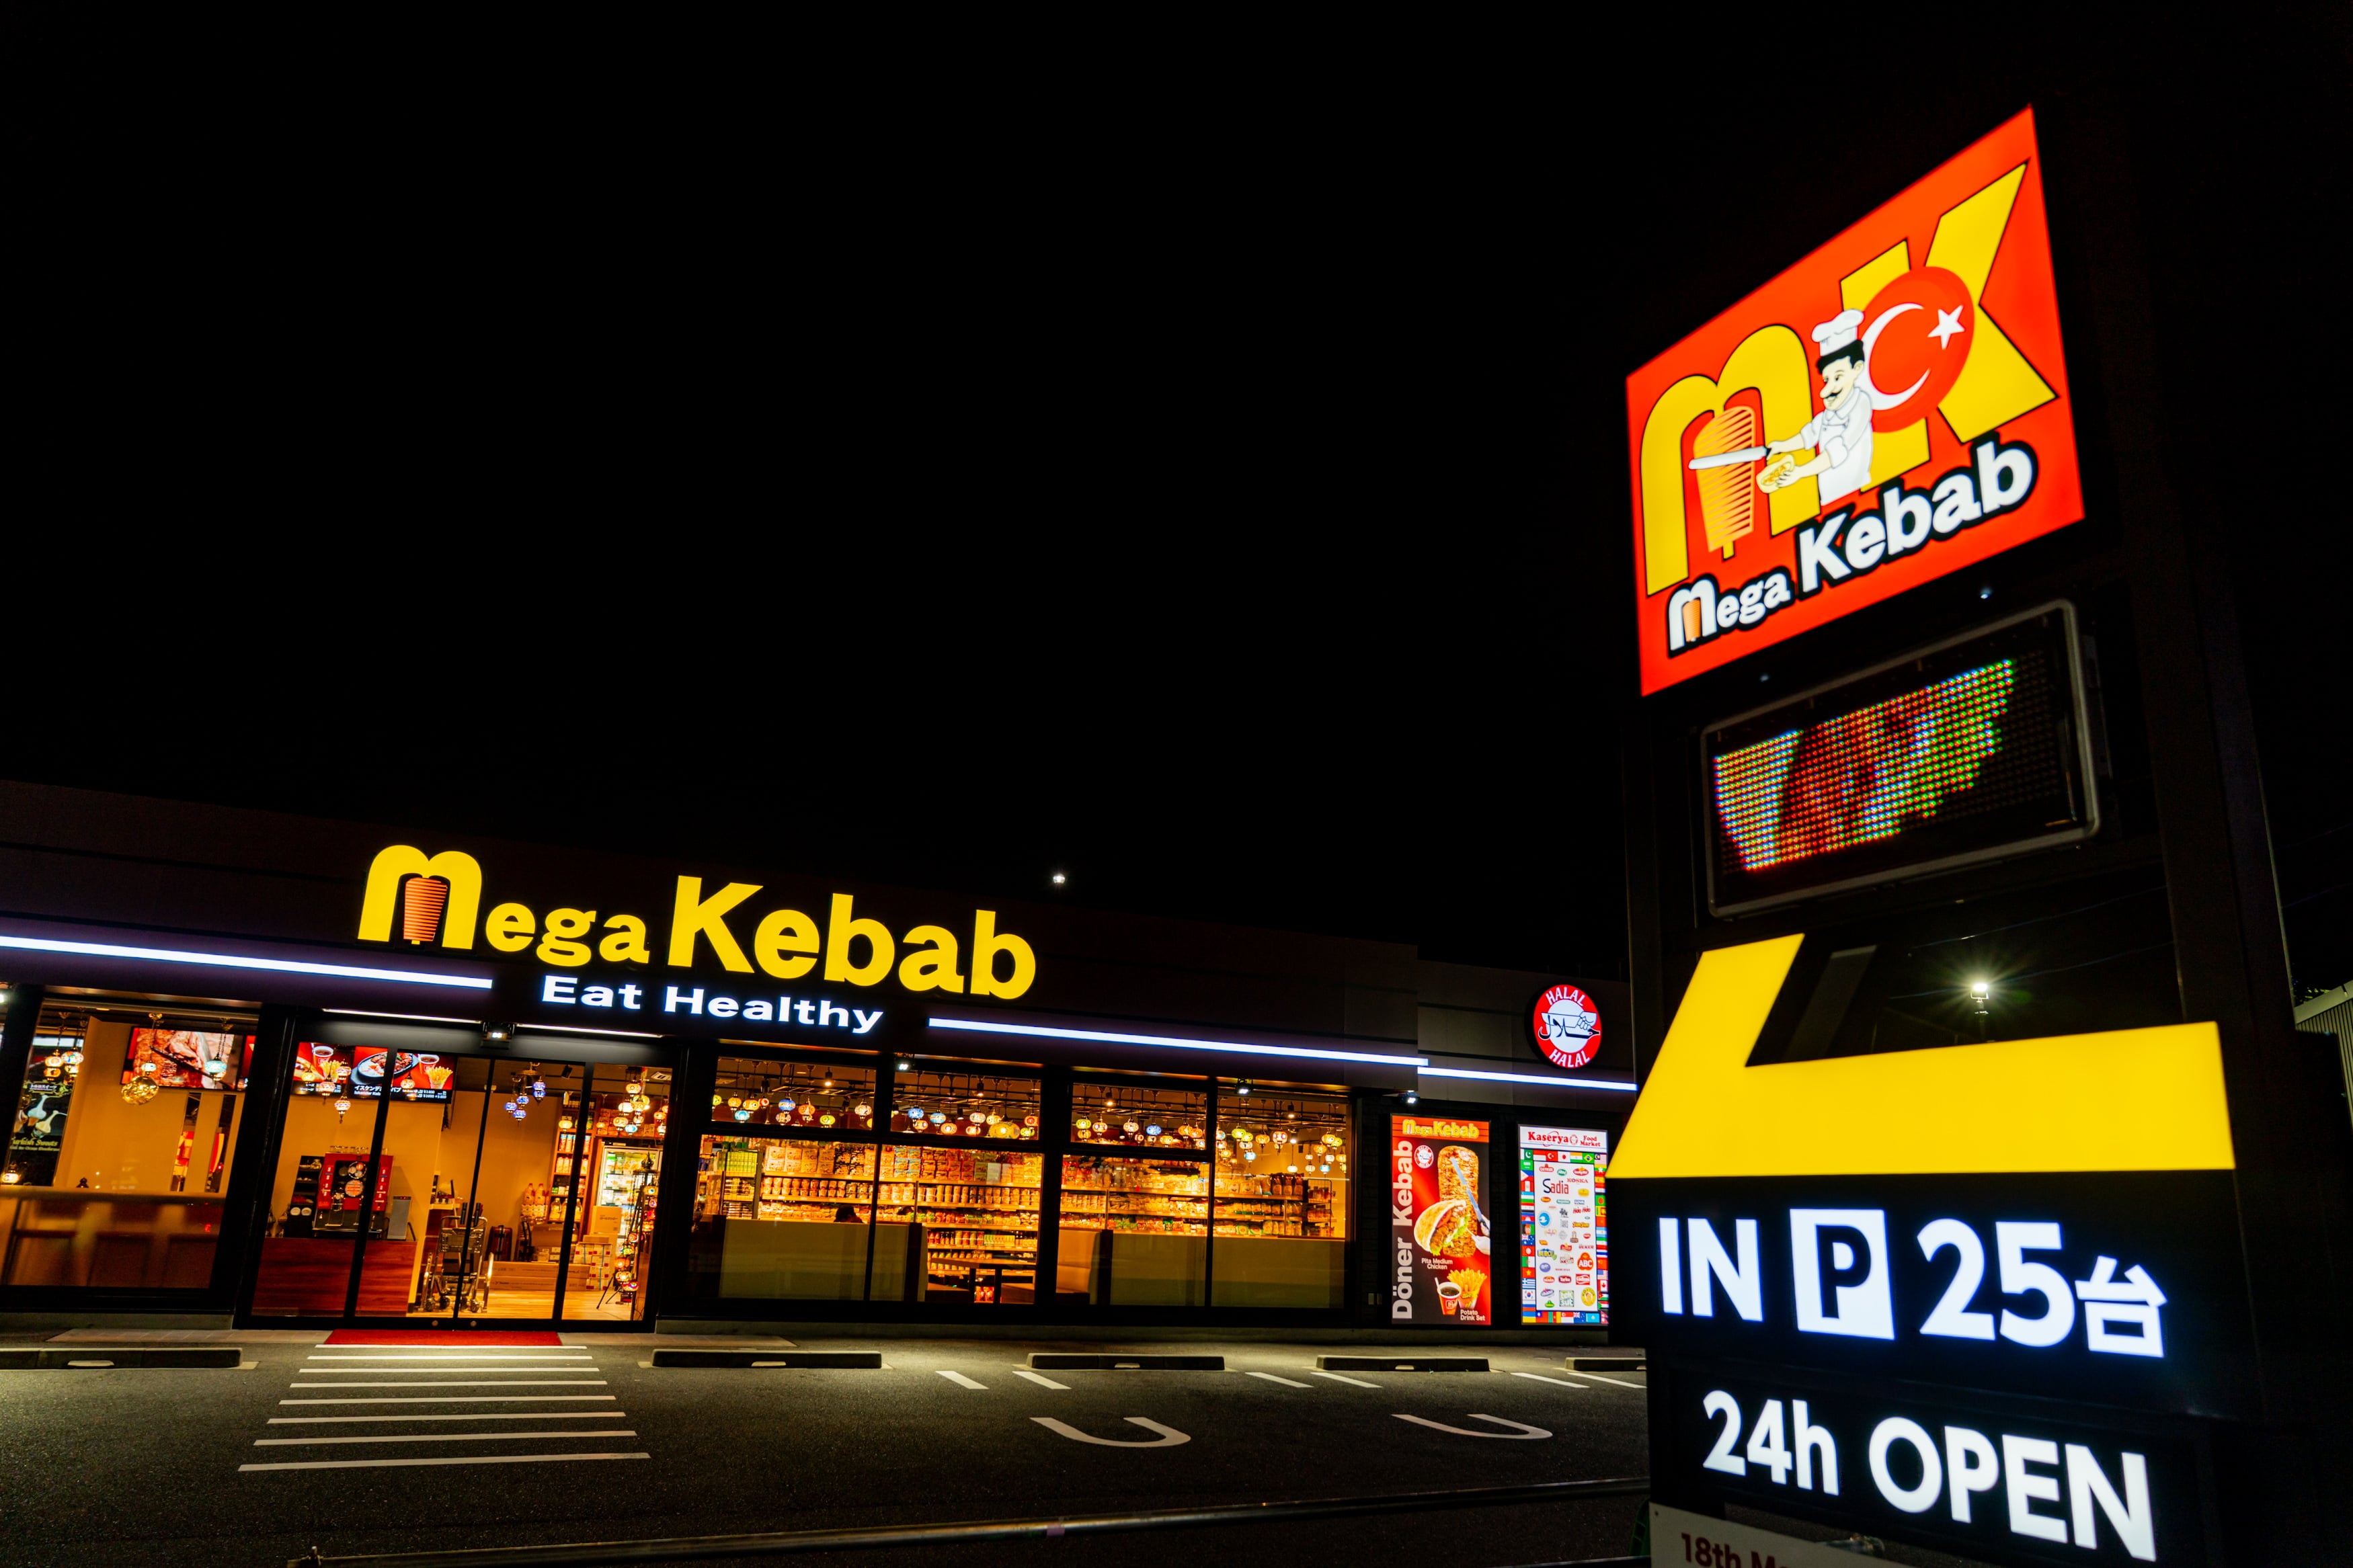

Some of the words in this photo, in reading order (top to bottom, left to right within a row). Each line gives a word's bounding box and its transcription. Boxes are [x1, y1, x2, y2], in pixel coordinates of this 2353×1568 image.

[1669, 573, 1791, 651] Mega
[1799, 441, 2034, 593] Kebab
[358, 845, 650, 966] Mega
[668, 875, 1036, 999] Kebab
[542, 975, 643, 1009] Eat
[664, 986, 883, 1034] Healthy
[1546, 987, 1585, 1006] HALAL
[1549, 1049, 1590, 1067] HALAL
[1402, 1119, 1433, 1137] Mega
[1433, 1121, 1479, 1139] Kebab
[1527, 1132, 1568, 1144] Kaserya
[1393, 1141, 1412, 1227] Kebab
[1543, 1178, 1568, 1194] Sadia
[1392, 1237, 1412, 1319] Döner
[1579, 1259, 1593, 1267] ABC
[1659, 1218, 1763, 1321] IN
[1702, 1389, 1839, 1496] 24h
[1868, 1416, 2156, 1562] OPEN
[1681, 1532, 1741, 1568] 18th
